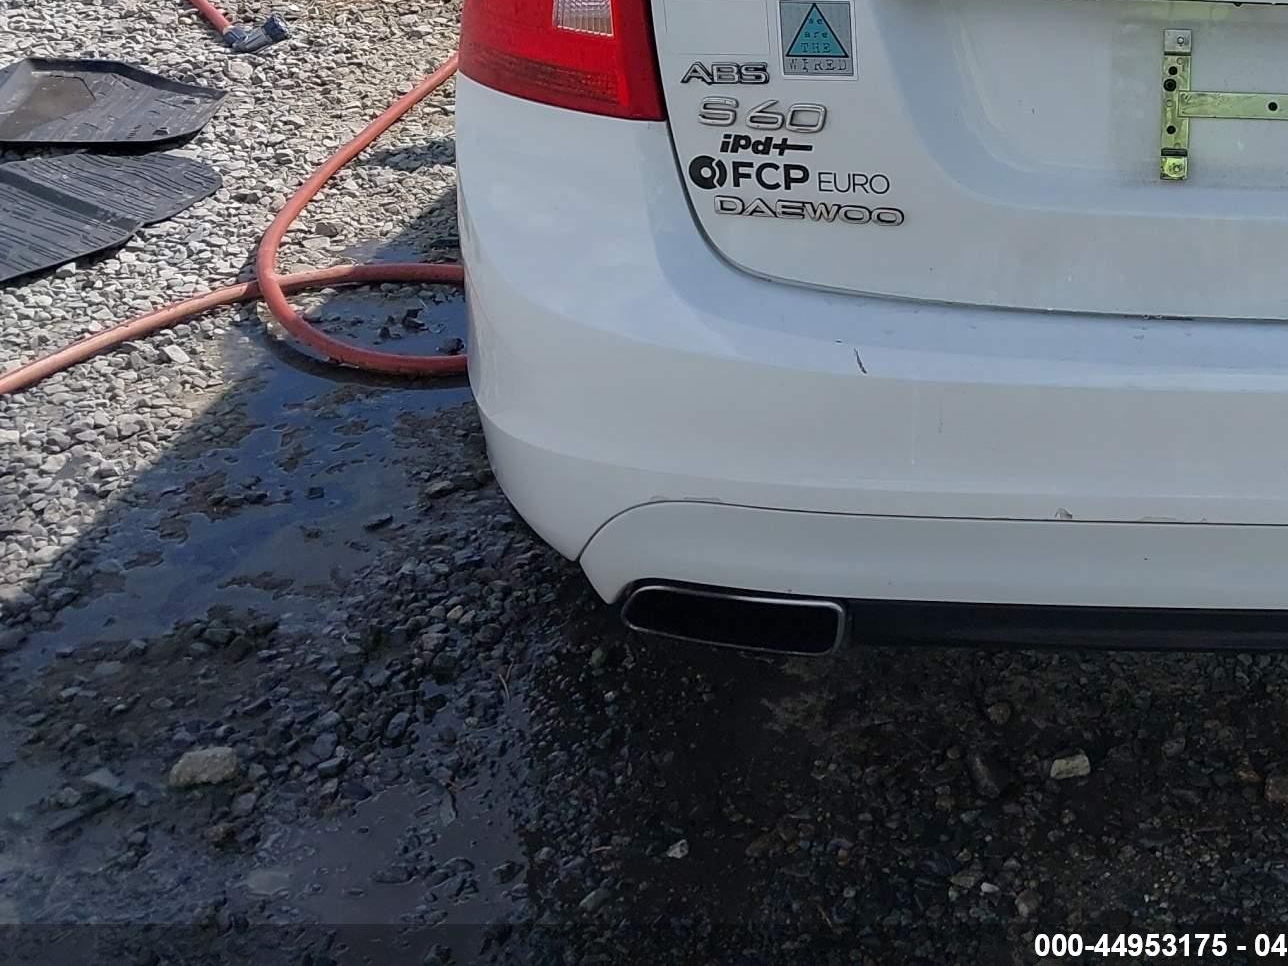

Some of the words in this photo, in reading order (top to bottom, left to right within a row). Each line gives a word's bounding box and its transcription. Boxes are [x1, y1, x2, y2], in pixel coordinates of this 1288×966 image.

[801, 43, 832, 53] THE
[681, 62, 769, 84] ABS
[789, 59, 848, 72] WIRED
[698, 96, 827, 132] S60
[733, 162, 809, 190] FCP
[818, 171, 890, 194] EURO
[714, 196, 904, 226] DAEWOO
